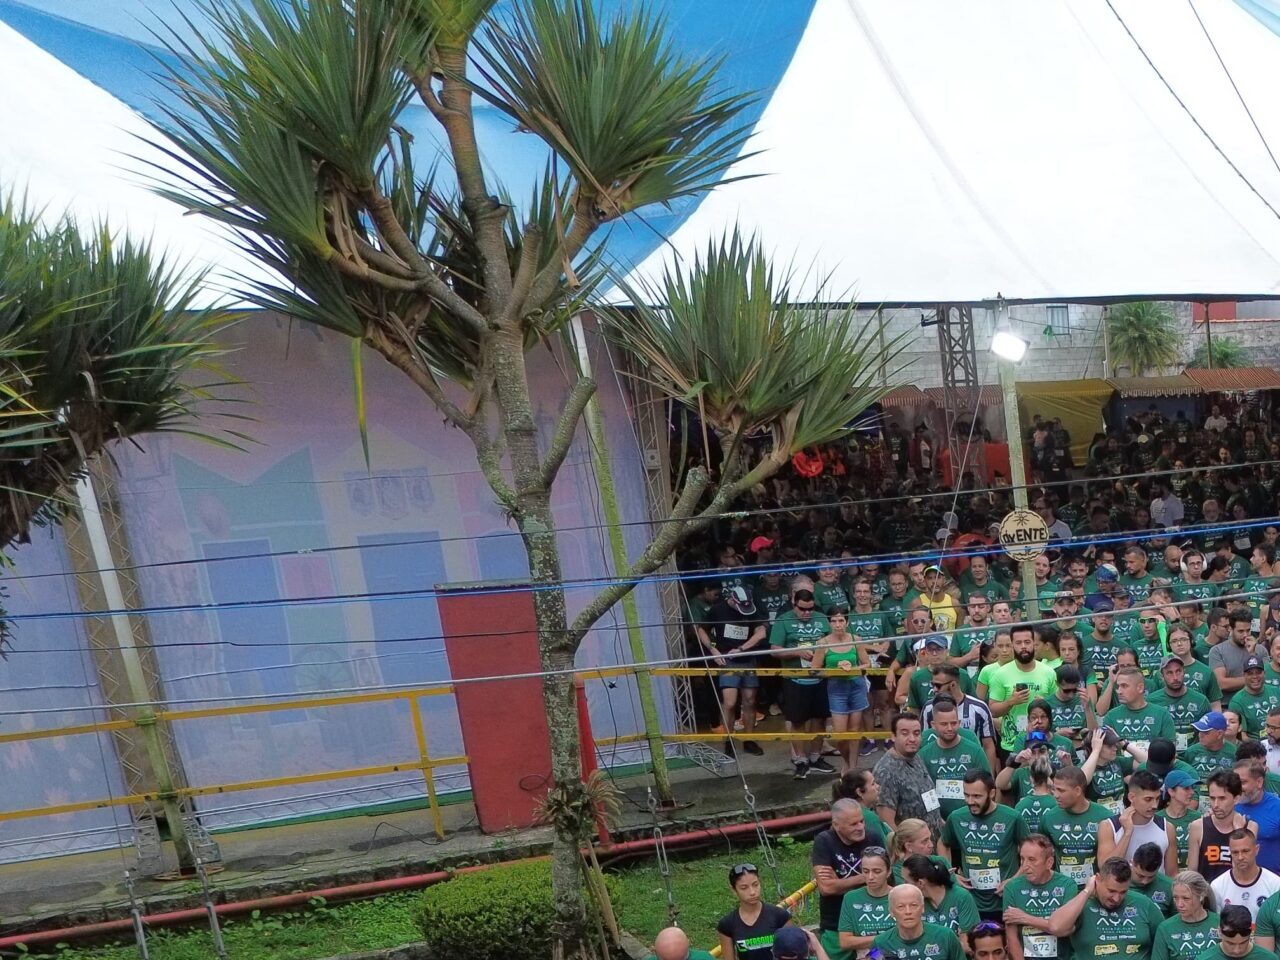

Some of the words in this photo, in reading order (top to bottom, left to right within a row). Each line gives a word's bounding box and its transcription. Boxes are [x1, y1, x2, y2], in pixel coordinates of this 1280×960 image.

[1070, 871, 1086, 880] 866
[978, 876, 994, 885] 485
[1033, 944, 1050, 952] 872
